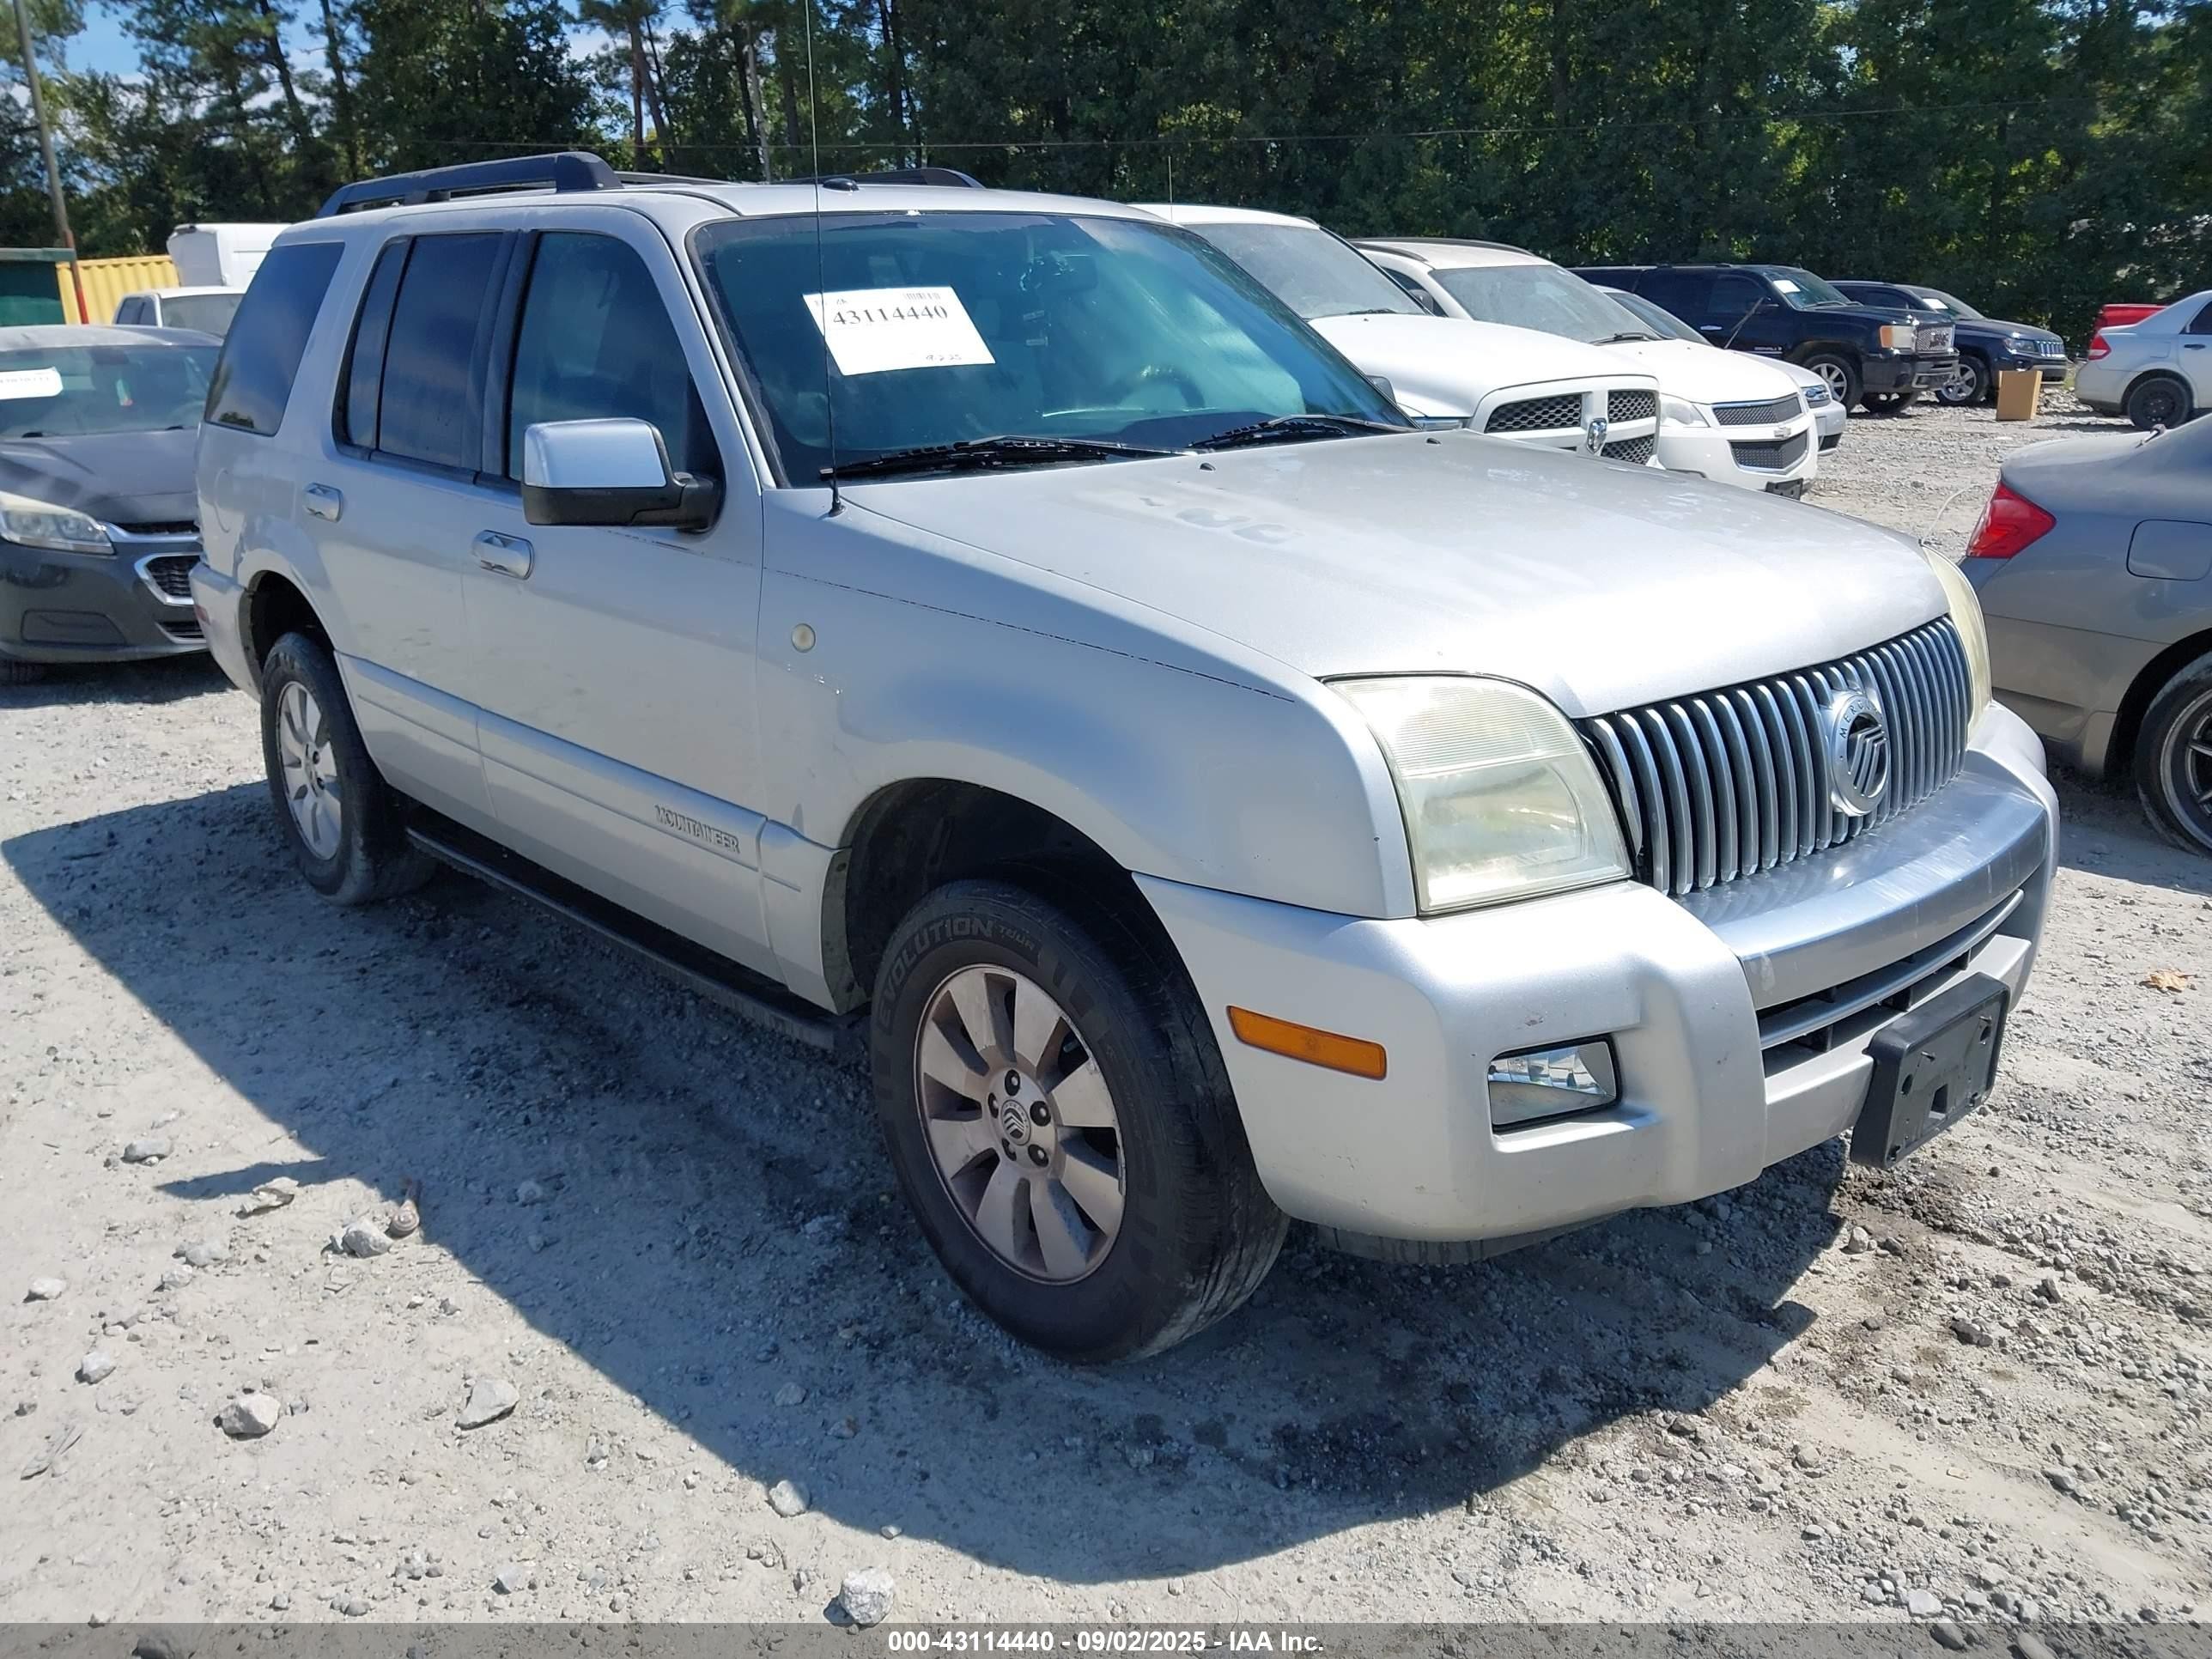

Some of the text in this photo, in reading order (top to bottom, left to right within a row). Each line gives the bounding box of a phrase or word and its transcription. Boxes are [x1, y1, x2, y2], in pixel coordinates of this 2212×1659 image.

[833, 305, 948, 325] 43114440
[1838, 698, 1881, 739] MERC
[654, 805, 740, 854] MOUNTAINEER
[878, 916, 994, 1026] EVOLUTION
